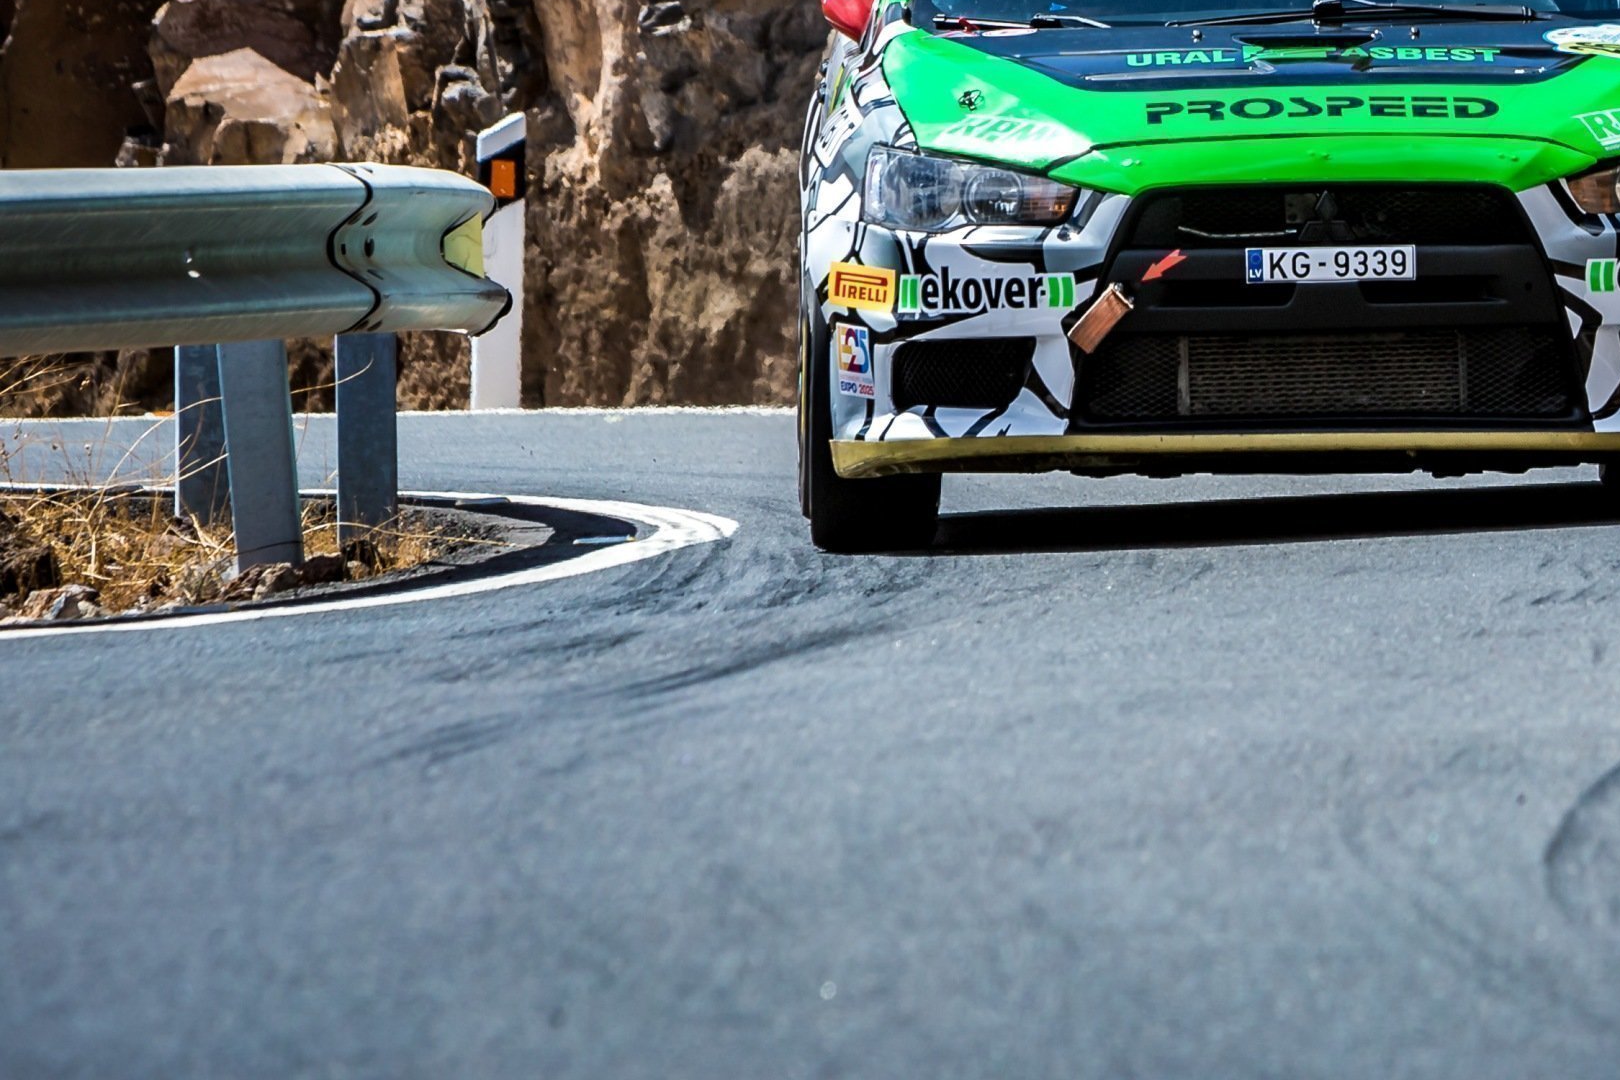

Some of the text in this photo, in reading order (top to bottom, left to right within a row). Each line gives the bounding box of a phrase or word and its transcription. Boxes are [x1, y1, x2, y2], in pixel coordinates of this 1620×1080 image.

[1126, 46, 1500, 67] URAL ASBEST
[1145, 95, 1500, 125] PROSPEED
[1249, 268, 1263, 279] LV
[834, 270, 888, 304] PIRELLI
[840, 380, 858, 394] EXPO
